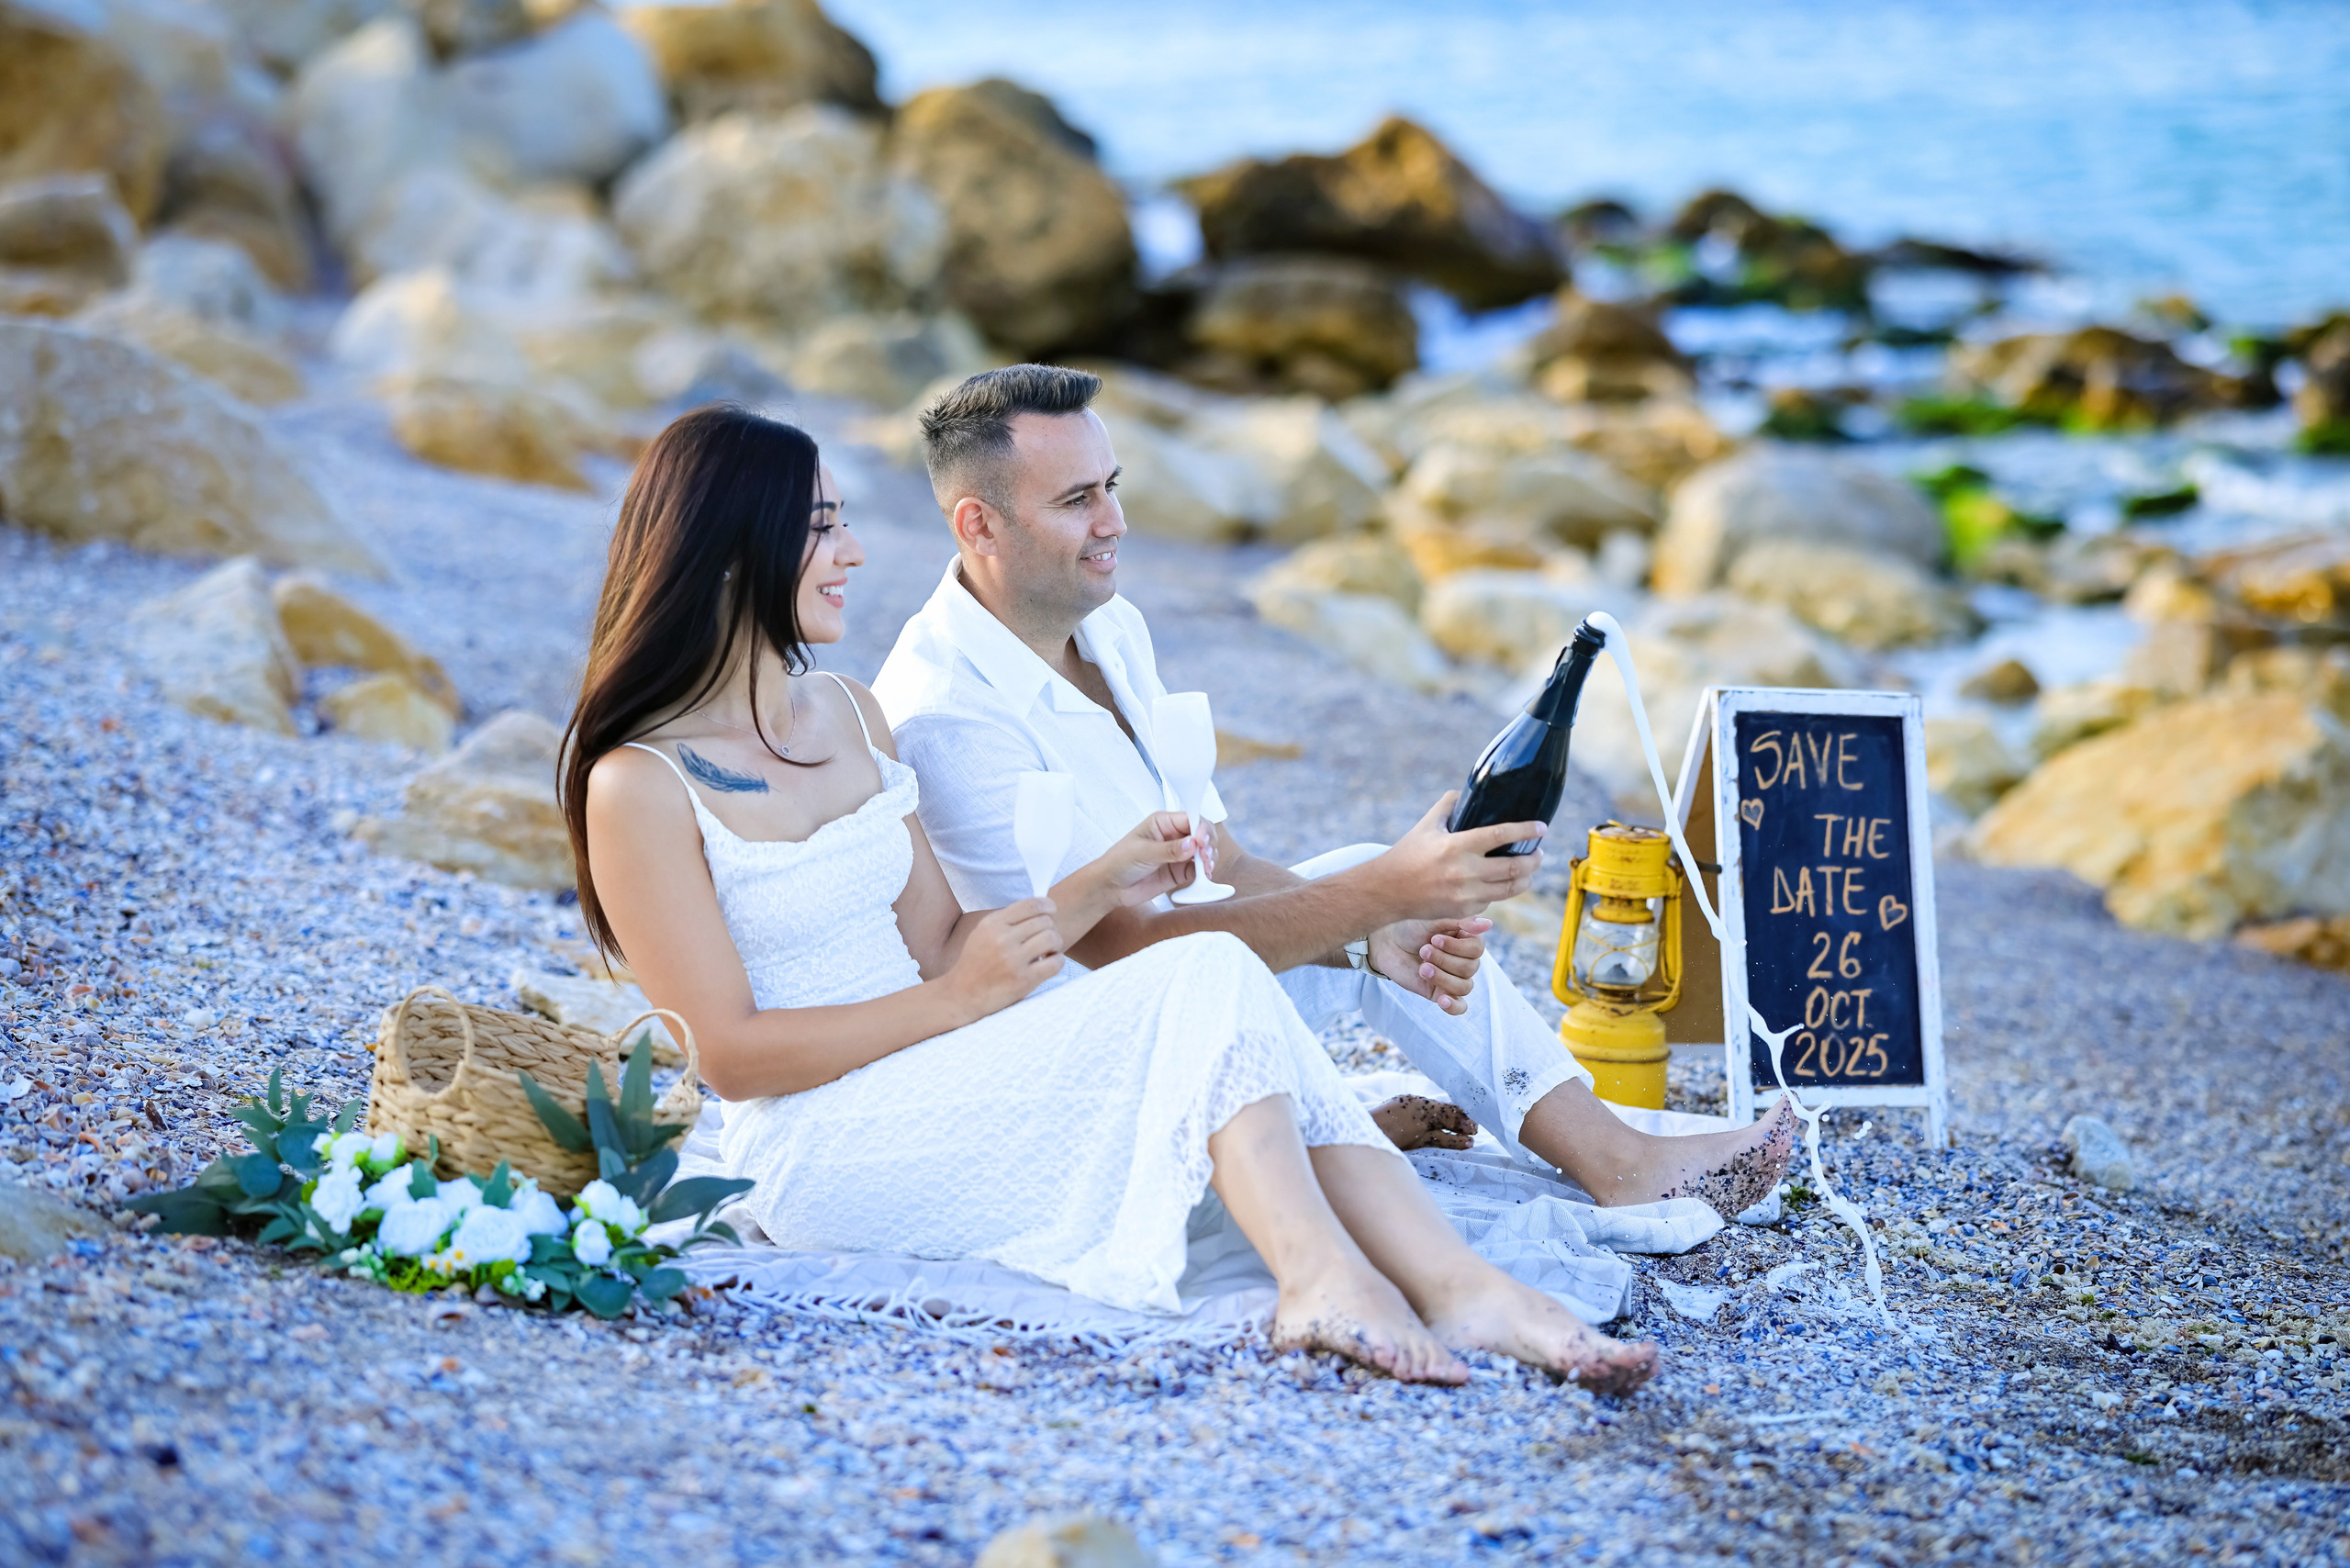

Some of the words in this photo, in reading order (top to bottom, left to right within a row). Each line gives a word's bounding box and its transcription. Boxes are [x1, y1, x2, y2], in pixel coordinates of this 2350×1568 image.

[1751, 731, 1863, 790] SAVE
[1814, 814, 1891, 857] THE
[1770, 867, 1866, 916] DATE
[1807, 932, 1862, 979] 26
[1805, 986, 1872, 1029] OCT
[1794, 1032, 1889, 1077] 2025
